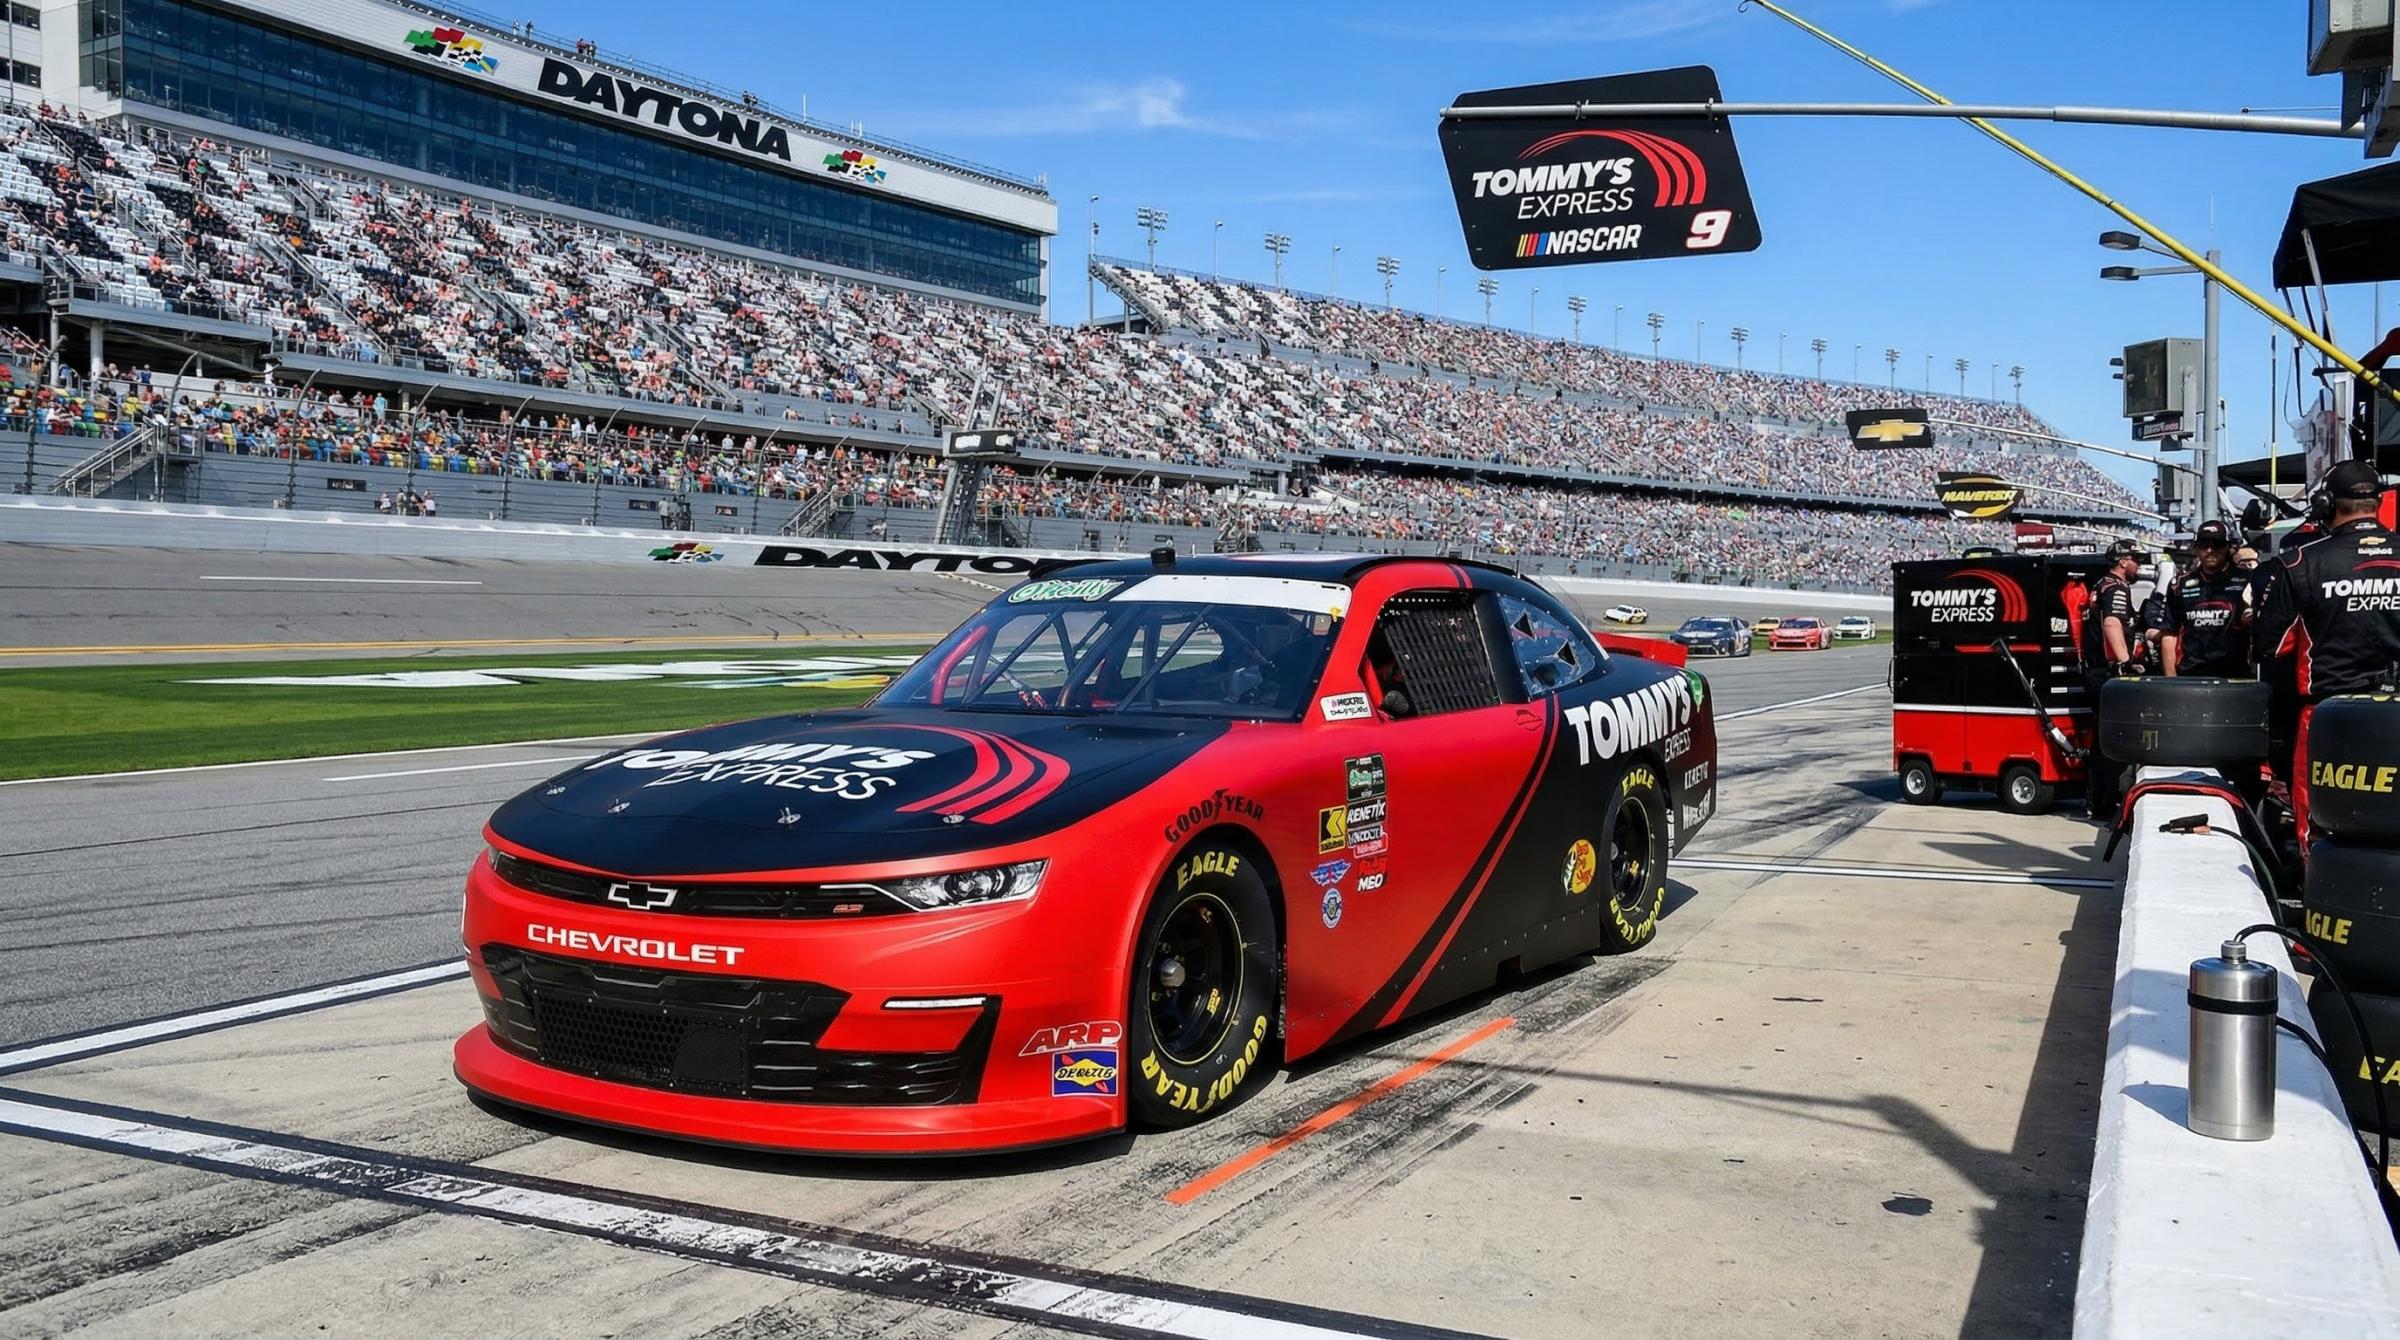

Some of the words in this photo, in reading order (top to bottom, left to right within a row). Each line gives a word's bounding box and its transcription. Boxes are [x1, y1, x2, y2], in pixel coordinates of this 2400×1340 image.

[537, 57, 791, 162] DAYTONA
[1472, 157, 1635, 198] TOMMY'S
[1517, 187, 1636, 220] EXPRESS
[1545, 224, 1643, 256] NASCAR
[1685, 210, 1733, 249] 9
[1911, 588, 1997, 607] TOMMY'S
[1931, 607, 1995, 623] EXPRESS
[1564, 675, 1691, 766] TOMMY'S
[583, 743, 936, 771] TOMMY'S
[642, 763, 897, 800] EXPRESS
[1621, 767, 1655, 797] EAGLE
[2312, 760, 2398, 793] EAGLE
[1177, 851, 1240, 893] EAGLE
[527, 923, 745, 966] CHEVROLET
[1018, 1021, 1122, 1056] ARP
